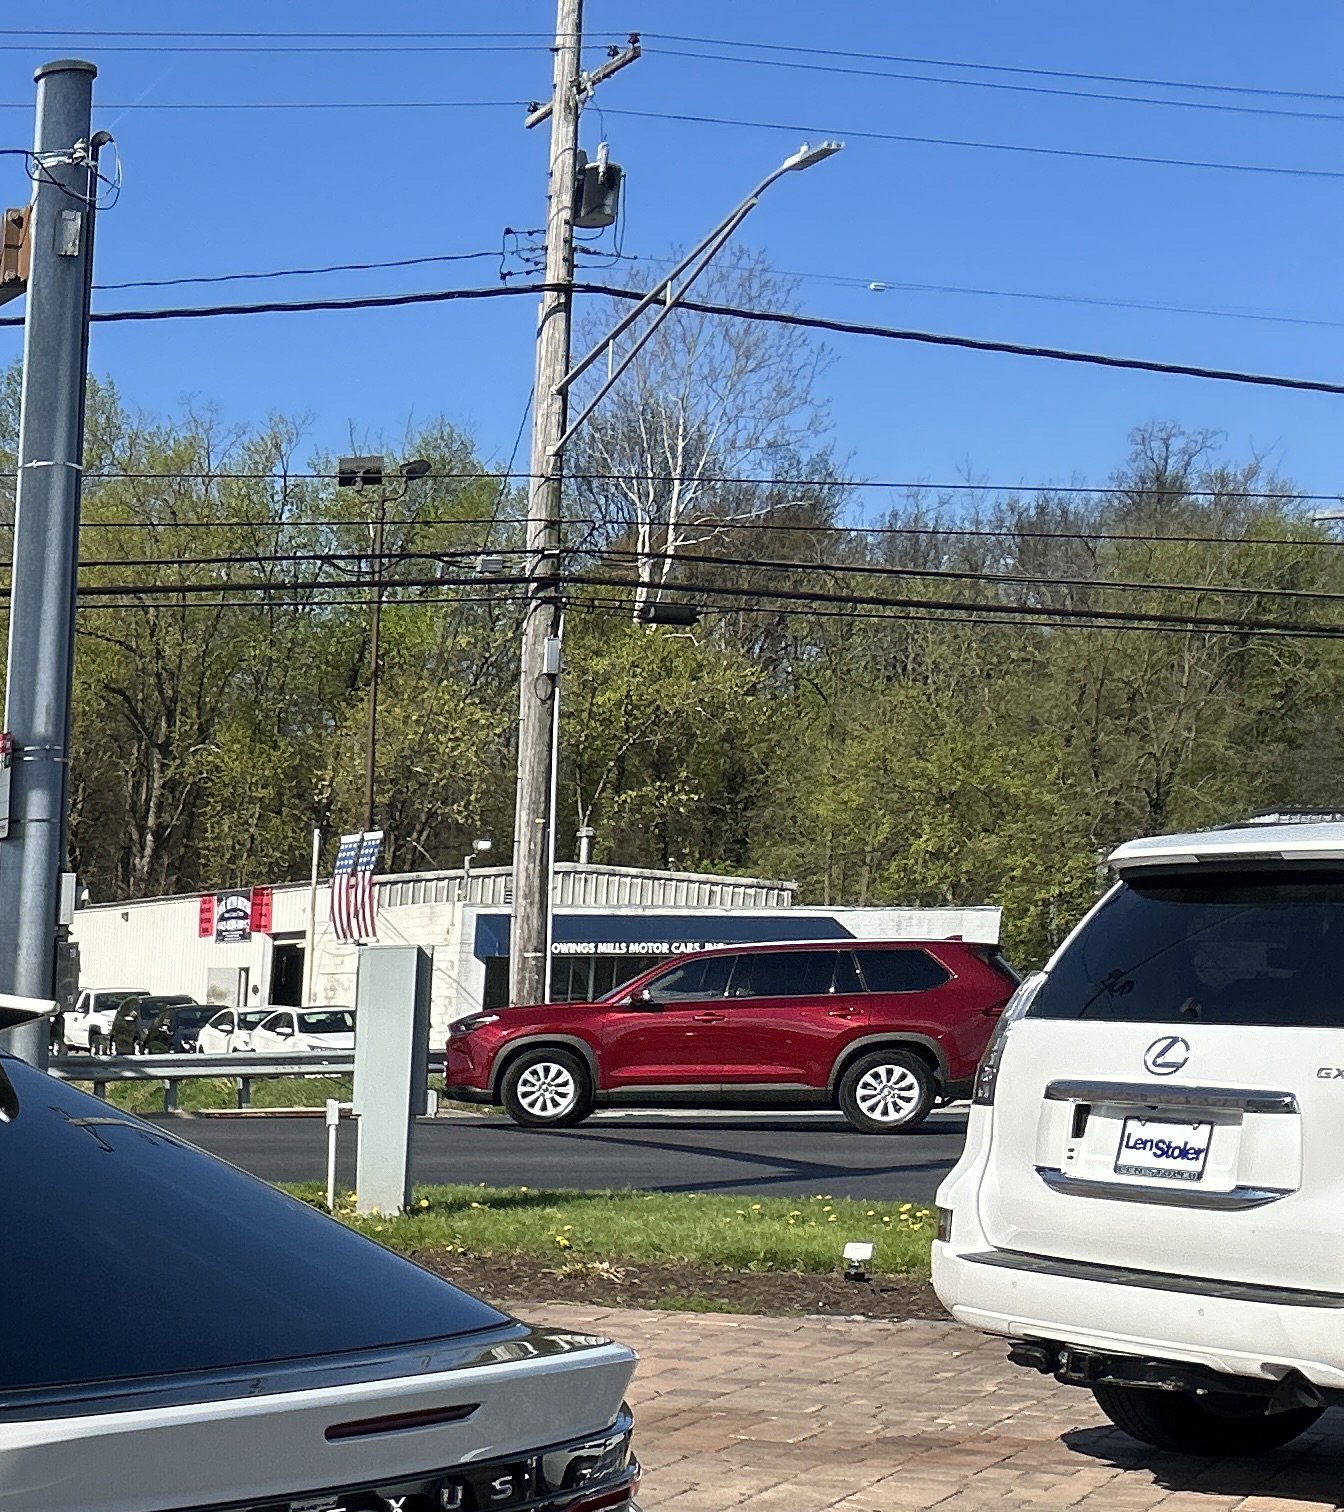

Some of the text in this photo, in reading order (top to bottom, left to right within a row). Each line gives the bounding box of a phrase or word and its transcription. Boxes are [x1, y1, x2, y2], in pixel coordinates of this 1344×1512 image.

[552, 942, 596, 954] OWINGS
[597, 942, 627, 954] MILLS
[628, 942, 669, 954] MOTOR
